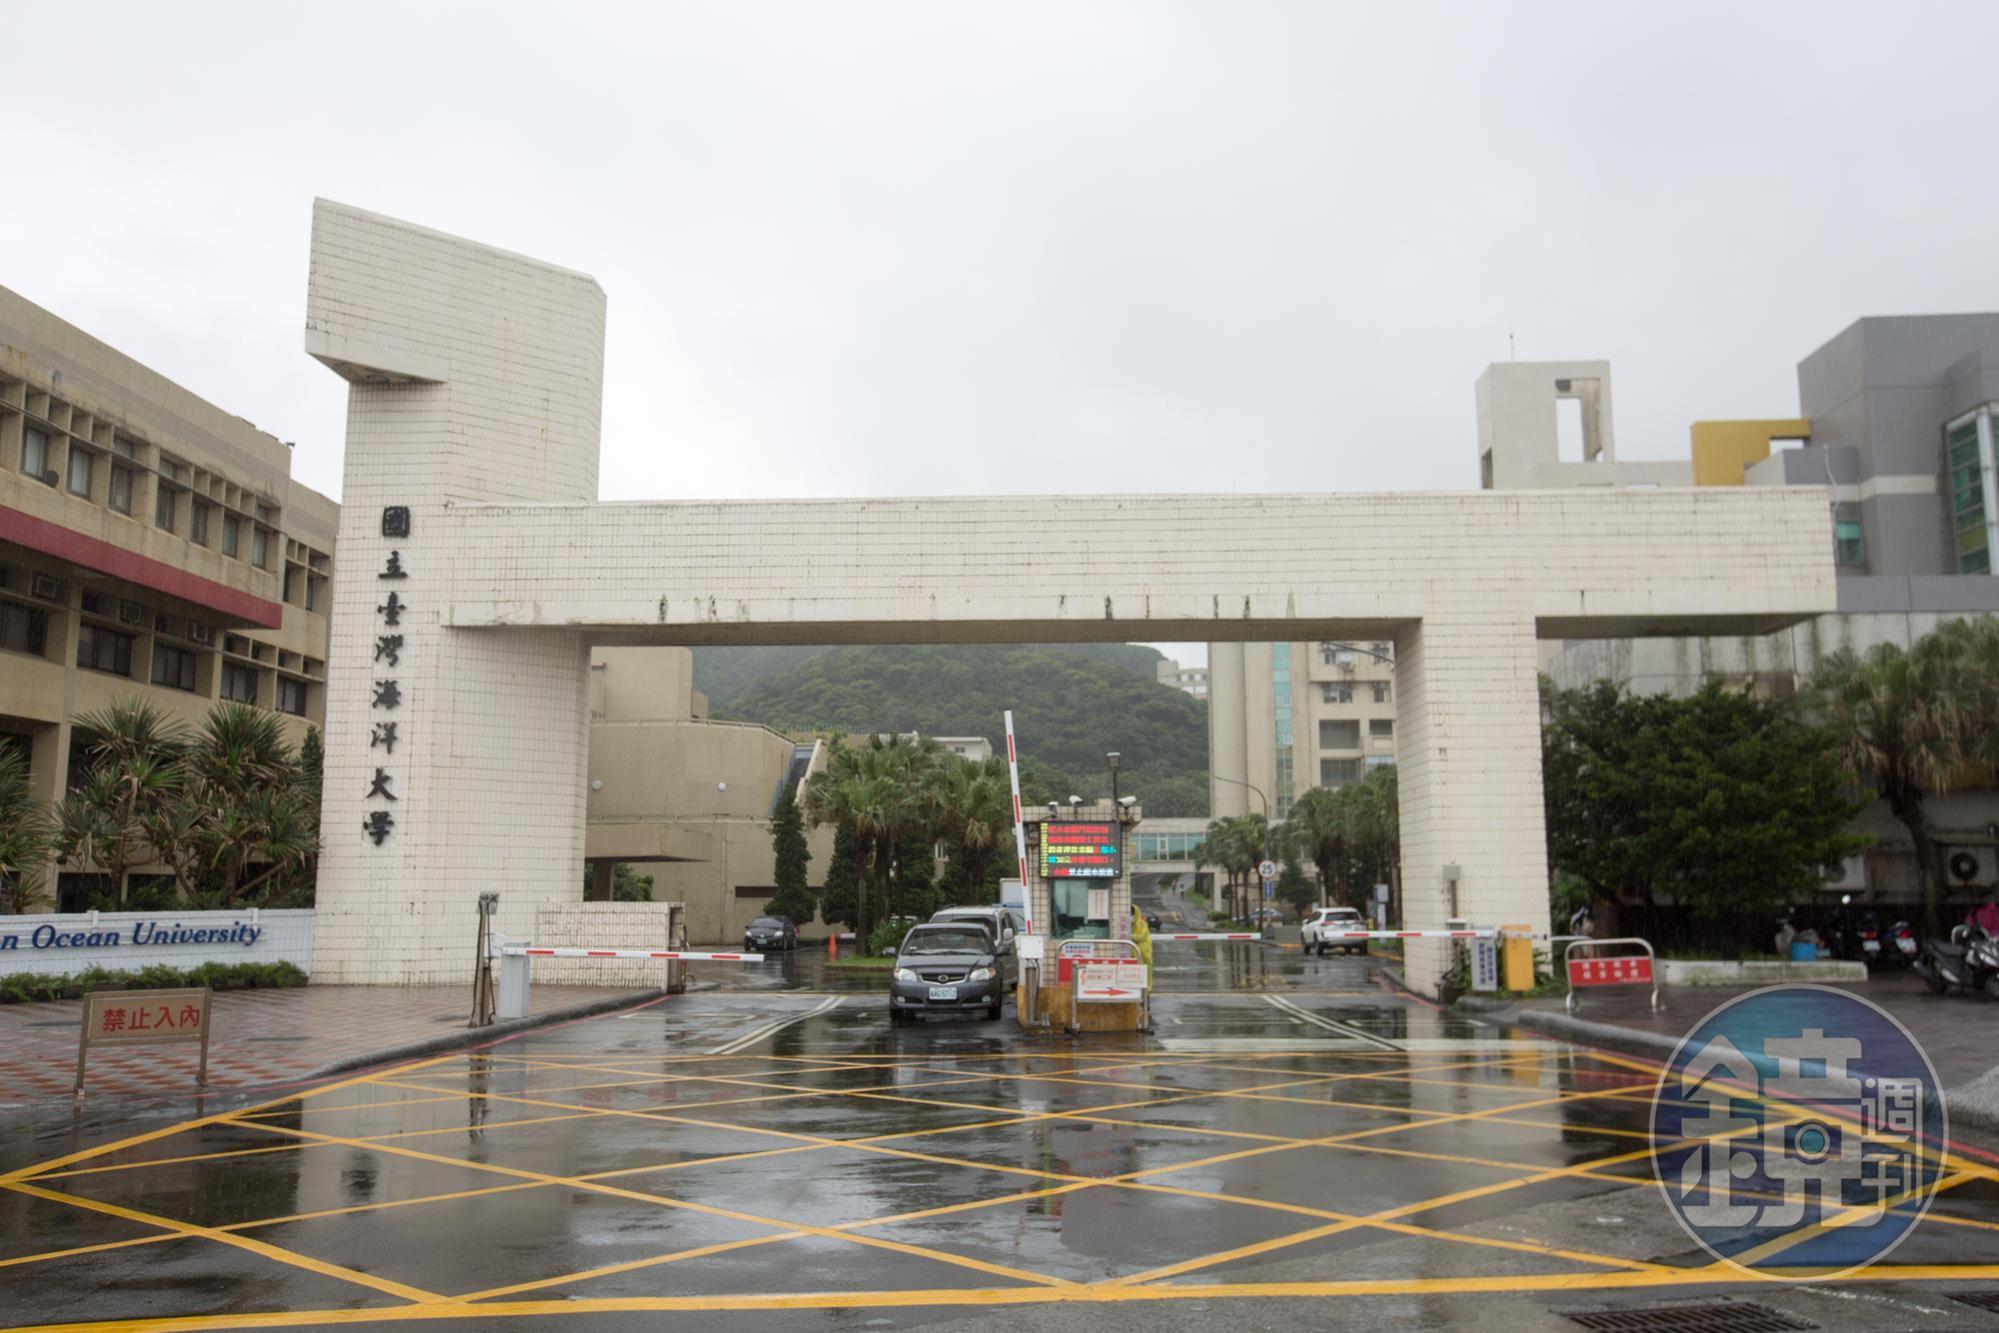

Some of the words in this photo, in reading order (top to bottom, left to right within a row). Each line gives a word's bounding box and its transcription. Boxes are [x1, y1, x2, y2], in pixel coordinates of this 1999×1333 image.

[1262, 864, 1273, 874] 25
[32, 924, 120, 949] Ocean
[132, 921, 262, 946] University
[103, 1004, 201, 1032] 禁止入內
